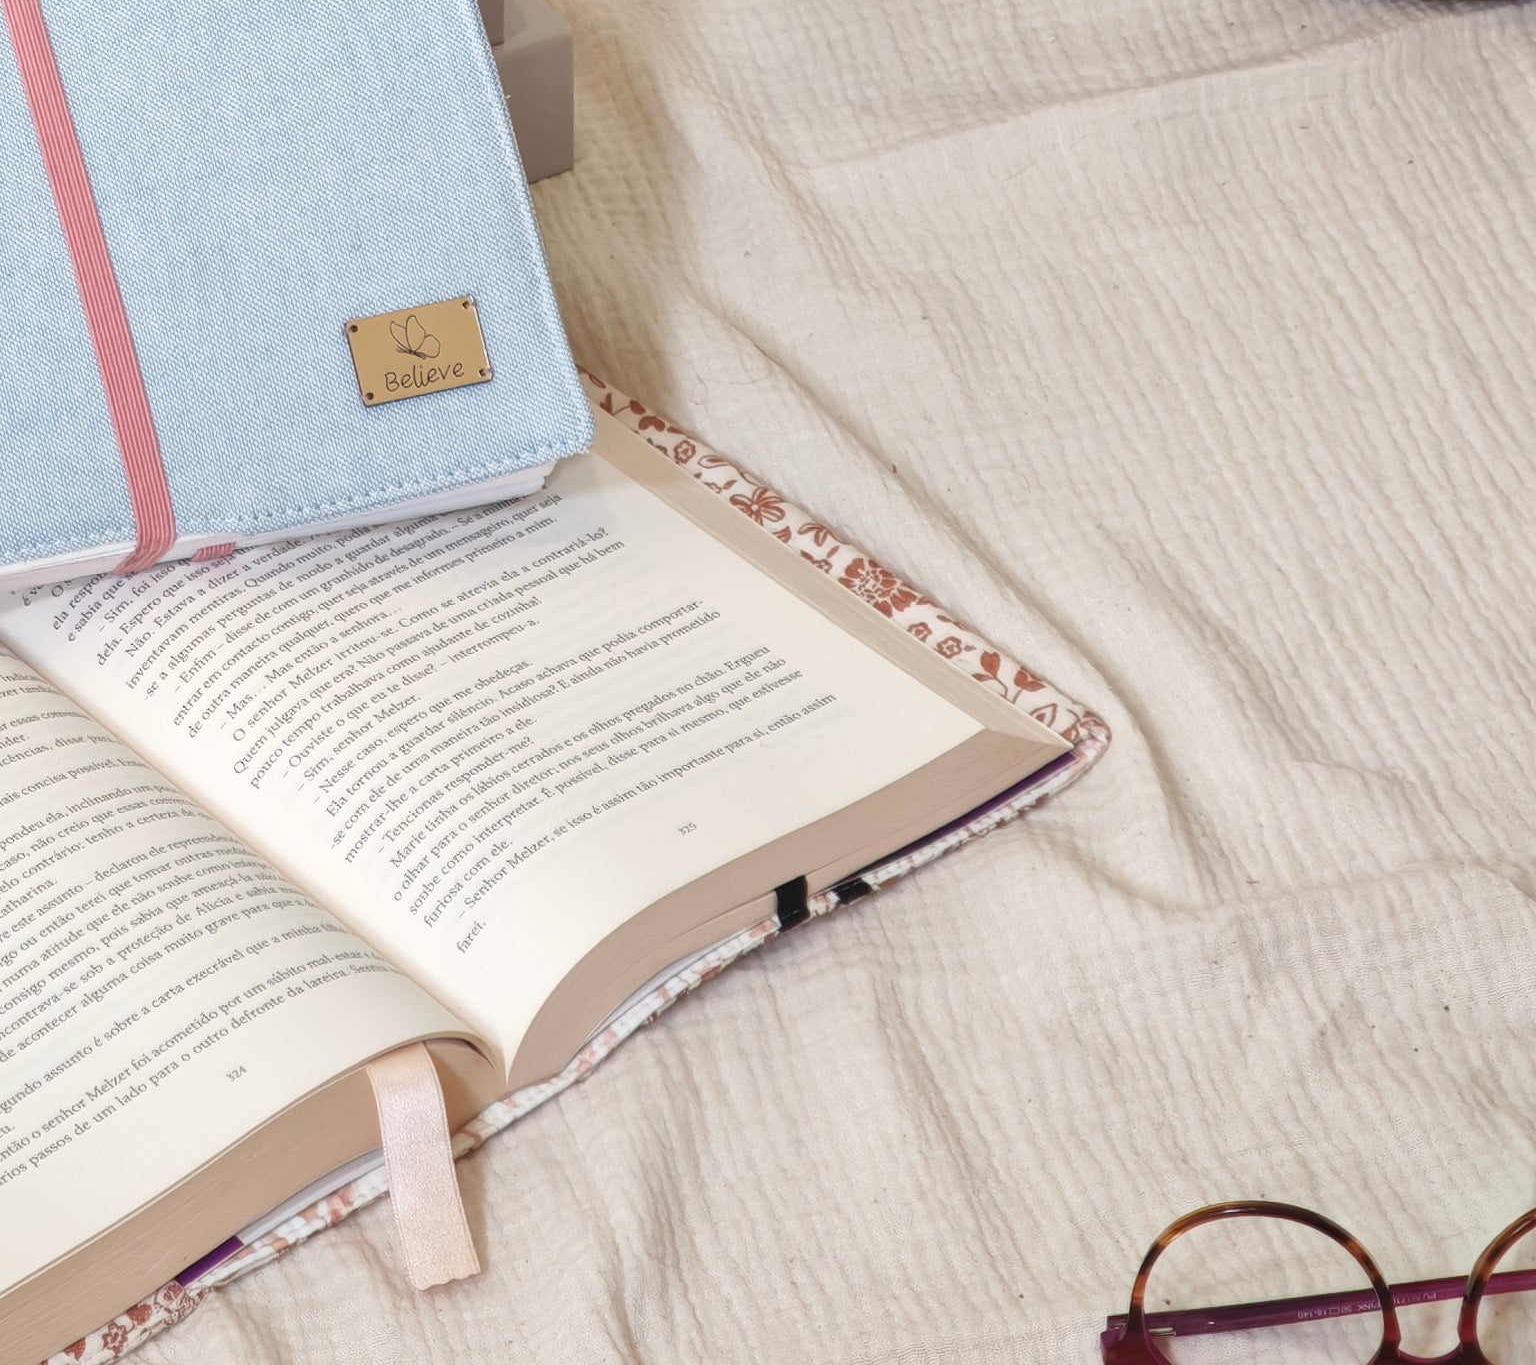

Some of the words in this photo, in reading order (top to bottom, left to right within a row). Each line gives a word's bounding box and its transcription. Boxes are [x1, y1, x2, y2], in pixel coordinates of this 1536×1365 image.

[384, 362, 466, 392] Believe
[124, 631, 155, 658] Não.
[152, 595, 196, 628] Estava
[196, 588, 207, 597] a
[207, 568, 240, 590] dizer
[241, 564, 252, 572] a
[252, 536, 306, 566] verdade.
[232, 727, 246, 742] O
[247, 688, 288, 728] senhor
[287, 658, 333, 690] Melzer
[333, 627, 399, 661] irritou-se.
[398, 606, 440, 628] Como
[440, 599, 456, 609] se
[456, 579, 500, 602] atrevia
[500, 570, 521, 582] ela
[520, 565, 531, 573] a
[531, 527, 609, 568] contrariá-lo?
[250, 748, 284, 790] pouco
[281, 712, 321, 747] tempo
[320, 672, 386, 713] trabalhava
[385, 654, 421, 675] como
[421, 628, 474, 657] ajudante
[473, 621, 491, 632] de
[490, 595, 543, 624] cozinha!
[389, 830, 427, 869] Marie
[424, 804, 460, 832] tinha
[458, 792, 475, 806] os
[470, 770, 512, 796] lábios
[511, 743, 565, 774] cerrados
[563, 739, 574, 747] e
[572, 731, 589, 743] os
[588, 716, 623, 735] olhos
[621, 691, 678, 722] pregados
[675, 683, 694, 695] no
[694, 669, 727, 687] chão.
[723, 646, 771, 671] Ergueu
[344, 793, 409, 864] mostrar-lhe
[408, 785, 419, 795] a
[418, 763, 451, 787] carta
[449, 732, 505, 768] primeiro
[504, 727, 516, 735] a
[515, 718, 538, 731] ele.
[423, 881, 464, 929] furiosa
[463, 856, 491, 882] com
[490, 841, 514, 857] ele.
[456, 920, 486, 954] farei.
[28, 1134, 73, 1169] passos
[74, 1121, 92, 1136] de
[92, 1105, 117, 1123] um
[114, 1083, 148, 1107] lado
[148, 1061, 180, 1088] para
[180, 1053, 191, 1062] o
[192, 1027, 229, 1054] outro
[230, 995, 286, 1030] defronte
[286, 986, 306, 998] da
[225, 1065, 247, 1083] 324
